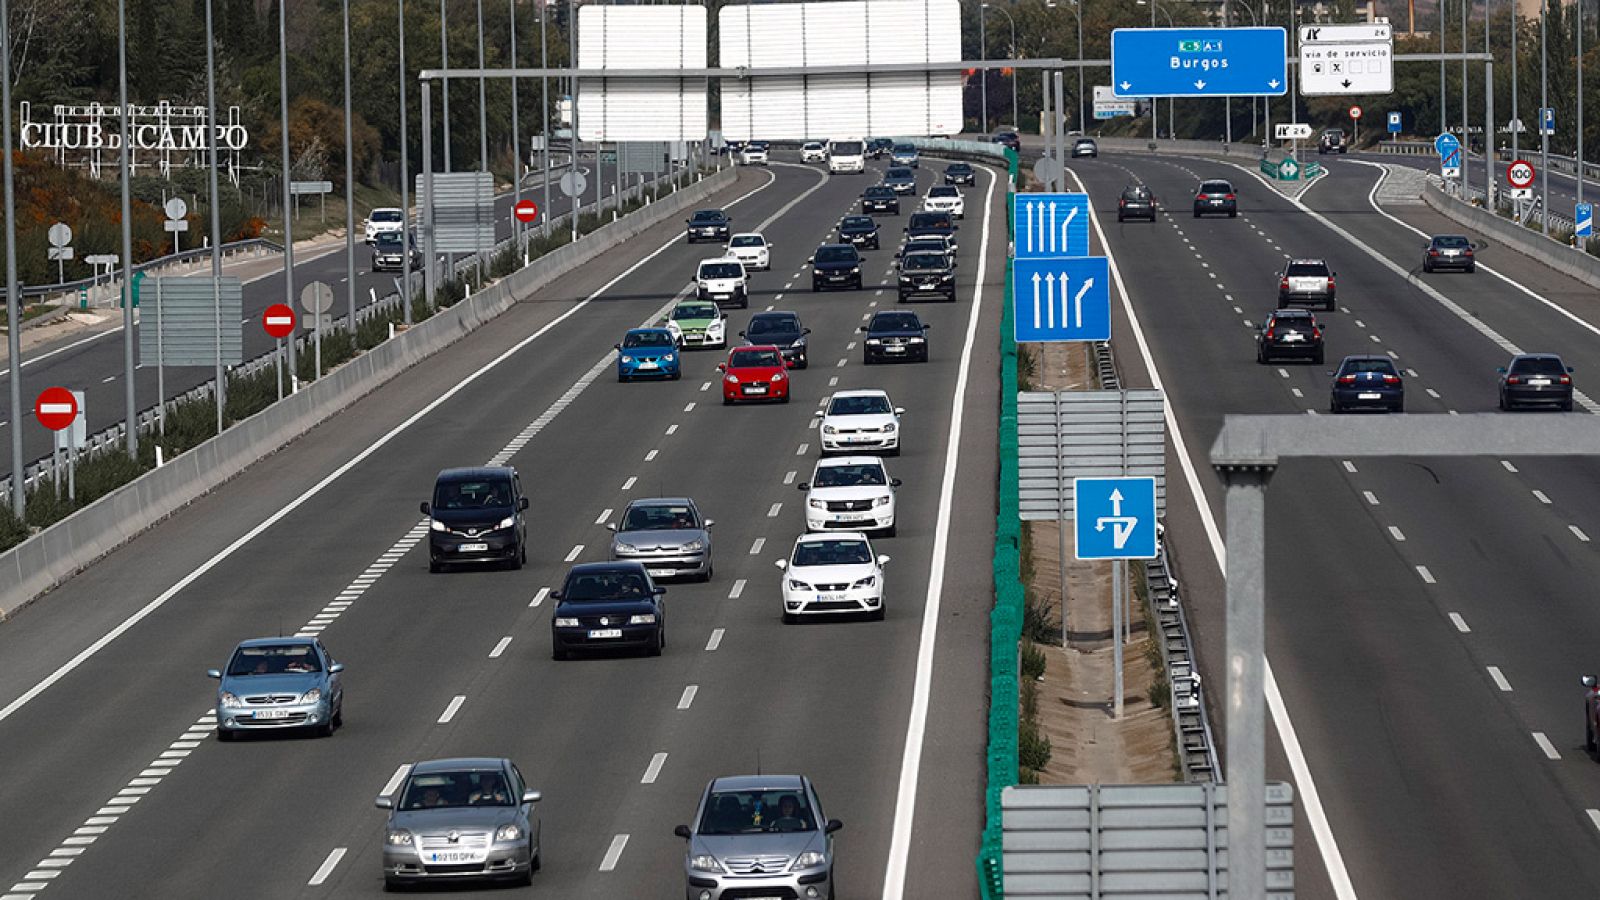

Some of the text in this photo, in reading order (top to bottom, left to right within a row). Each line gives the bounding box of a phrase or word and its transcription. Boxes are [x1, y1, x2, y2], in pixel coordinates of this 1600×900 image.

[1374, 29, 1386, 37] 26
[1203, 40, 1222, 51] A-1
[1326, 50, 1338, 58] de
[1344, 49, 1387, 57] servicio
[1170, 56, 1229, 71] Burgos
[54, 105, 213, 116] URBANIZACIO
[22, 124, 104, 149] CLUB
[137, 124, 248, 149] CAMPO
[1293, 127, 1306, 135] 26
[1511, 168, 1531, 179] 100
